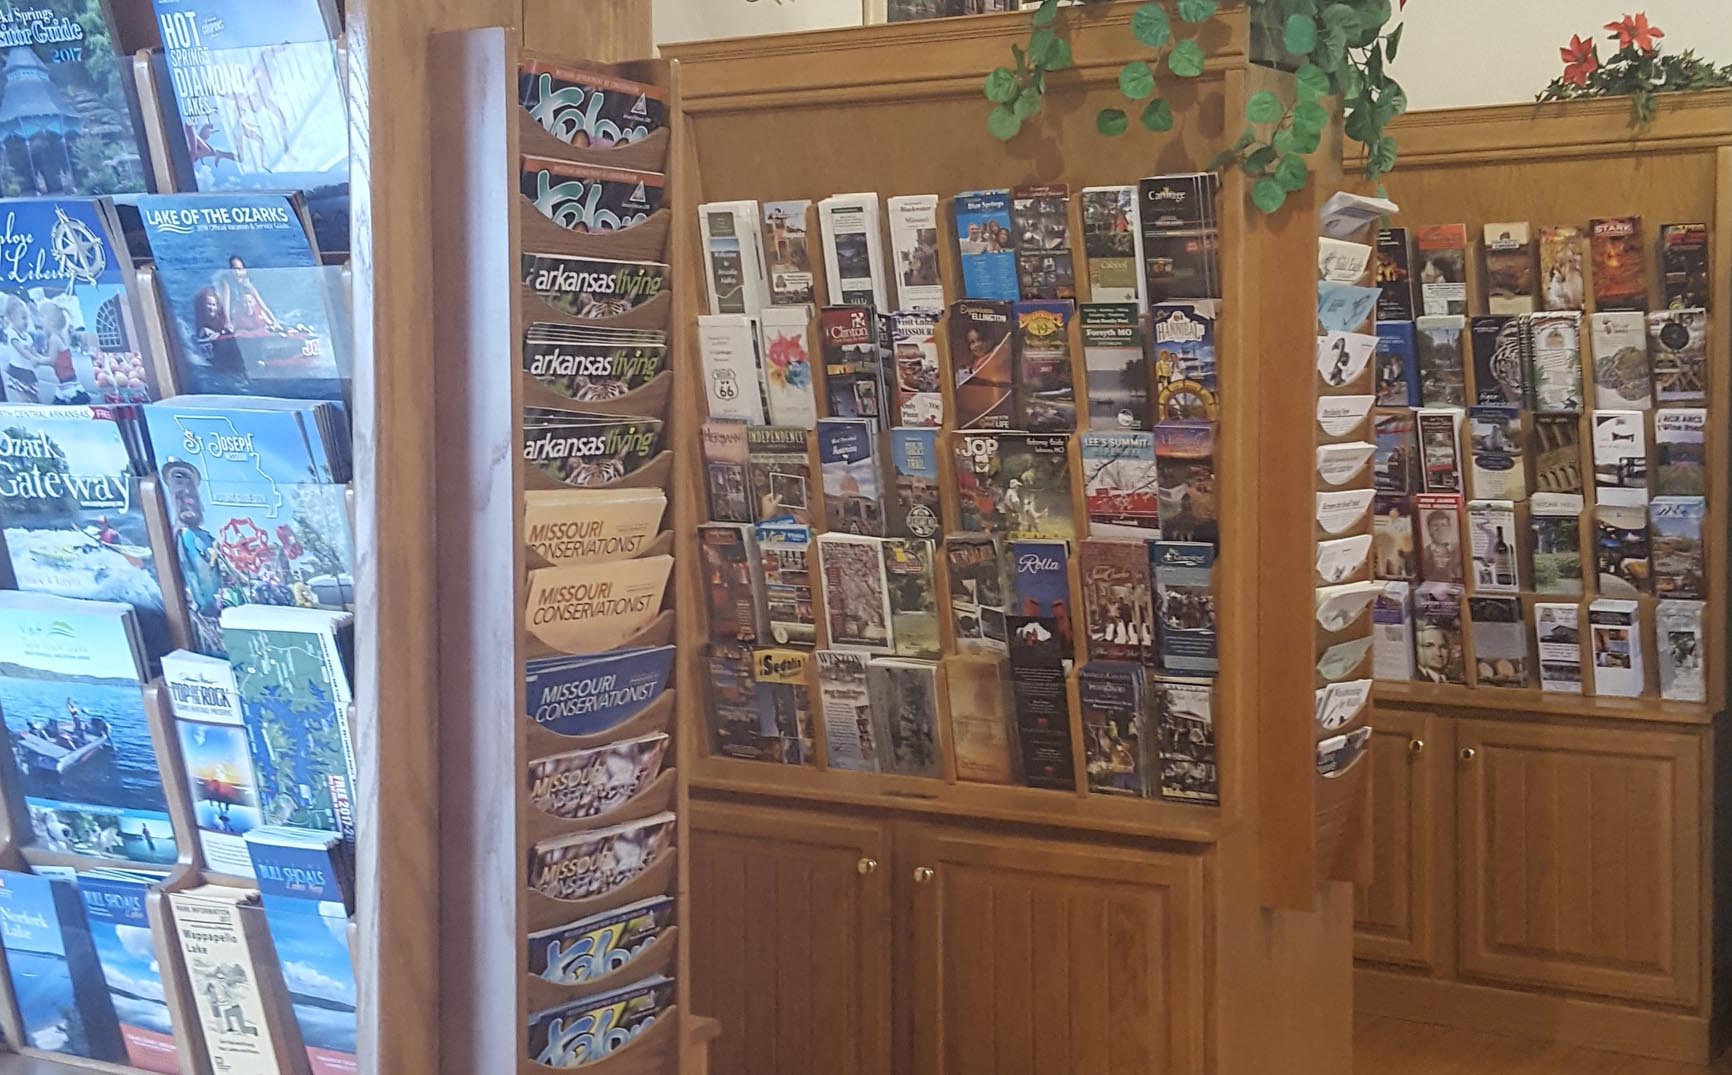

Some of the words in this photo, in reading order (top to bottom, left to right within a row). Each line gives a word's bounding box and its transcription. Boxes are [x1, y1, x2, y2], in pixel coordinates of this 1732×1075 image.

[12, 7, 54, 26] Springs
[32, 17, 84, 44] Guide
[160, 11, 201, 49] HOT
[52, 47, 82, 64] 2017
[170, 47, 209, 68] SPRINGS
[173, 64, 254, 98] DIAMOND
[181, 97, 211, 116] LAKES
[146, 209, 180, 225] LAKE
[181, 209, 200, 224] OF
[200, 208, 231, 224] THE
[231, 208, 288, 223] OZARKS
[1594, 222, 1633, 234] STARK
[535, 264, 616, 294] arkansas
[616, 268, 662, 295] living
[971, 313, 1007, 322] ELLINGTON
[831, 325, 868, 339] Clinton
[1086, 328, 1116, 338] Forsyth
[1117, 328, 1132, 336] MO
[530, 348, 612, 376] arkansas
[612, 350, 658, 380] living
[720, 386, 735, 397] 66
[995, 420, 1009, 428] LIFE
[0, 430, 60, 459] Ozark
[523, 433, 606, 460] arkansas
[606, 427, 654, 457] living
[748, 430, 804, 443] INDEPENDENCE
[1110, 438, 1147, 449] SUMMIT
[0, 461, 131, 514] Gateway
[530, 520, 604, 543] MISSOURI
[1018, 553, 1060, 574] Rolla
[539, 582, 612, 605] MISSOURI
[533, 594, 654, 626] CONSERVATIONIST
[541, 674, 616, 705] MISSOURI
[536, 681, 658, 723] CONSERVATIONIST
[283, 868, 326, 887] SHOALS
[104, 893, 141, 911] SHOALS
[182, 929, 239, 944] Wappapello
[186, 944, 209, 955] Lake
